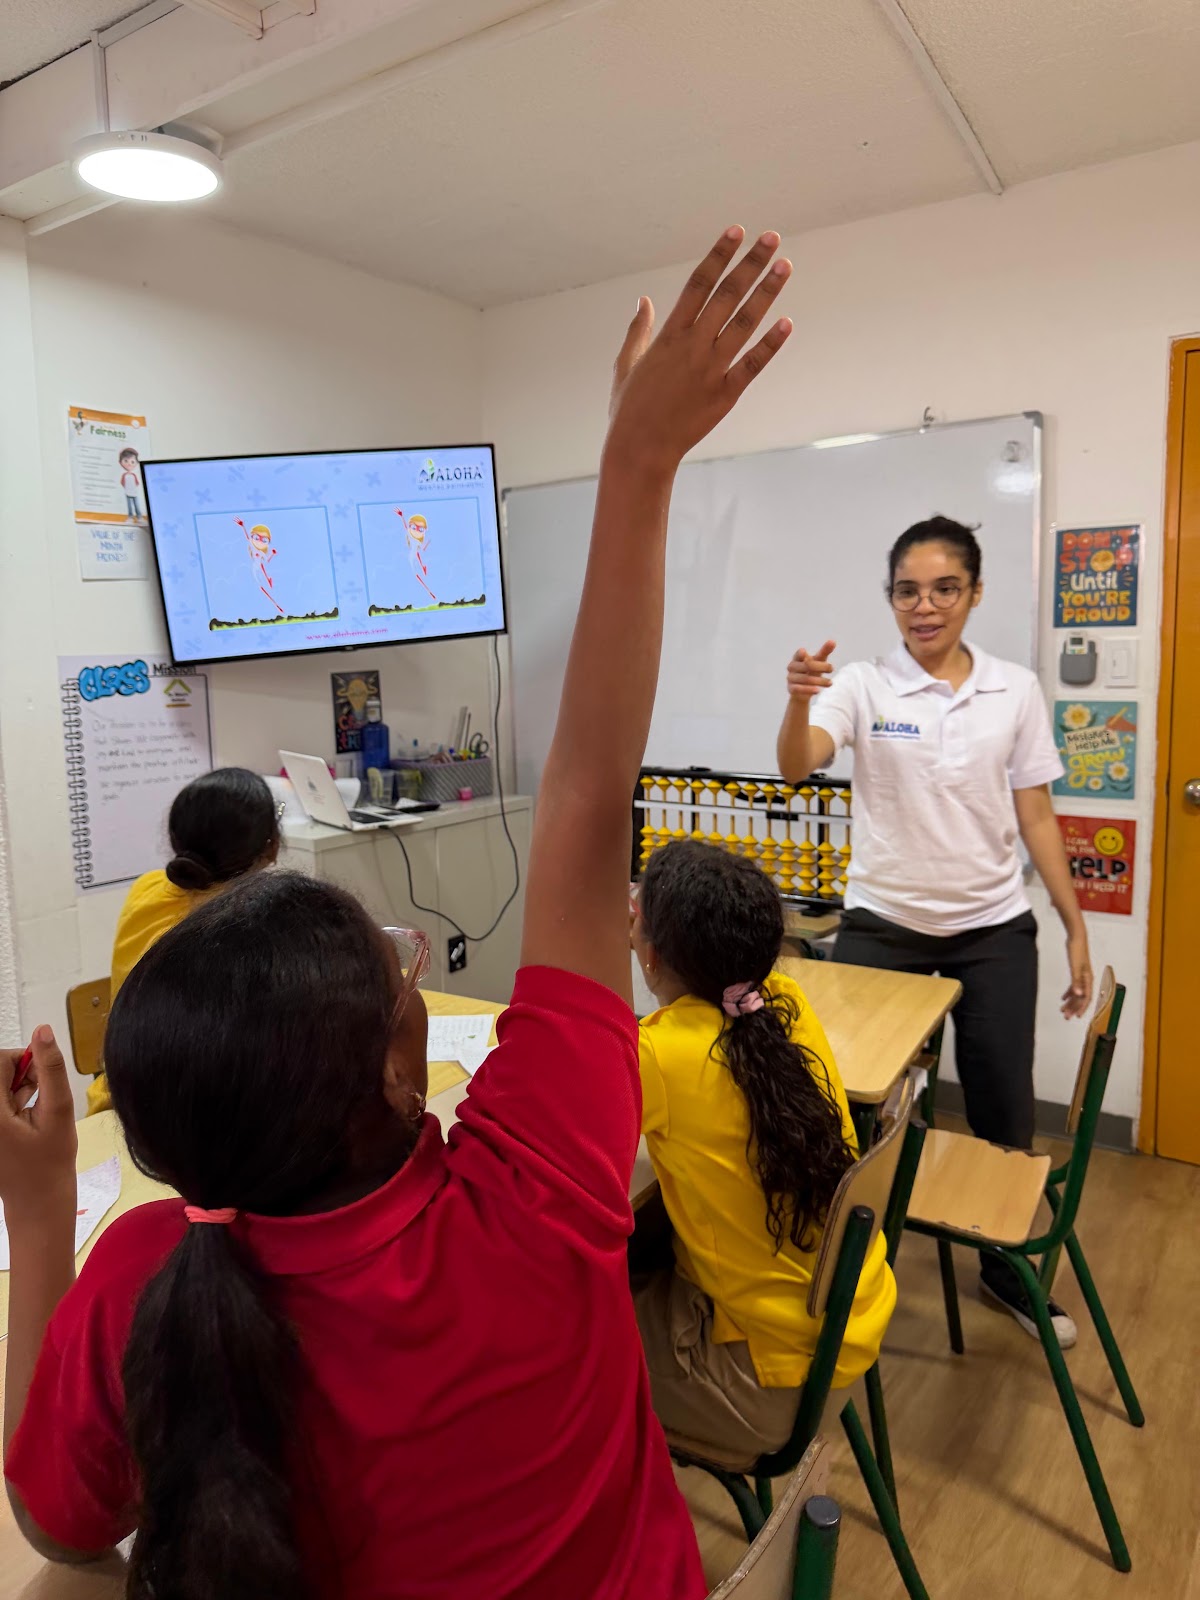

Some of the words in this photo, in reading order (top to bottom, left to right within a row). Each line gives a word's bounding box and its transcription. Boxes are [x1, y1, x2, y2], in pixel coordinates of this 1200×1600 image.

[90, 425, 126, 439] Fairness
[436, 466, 483, 481] ALOHA
[1062, 529, 1135, 551] DON'T
[1060, 546, 1134, 573] STOP
[1070, 571, 1118, 592] Until
[1060, 590, 1131, 607] YOU'RE
[1062, 605, 1131, 624] PROUD
[884, 722, 920, 735] ALOHA
